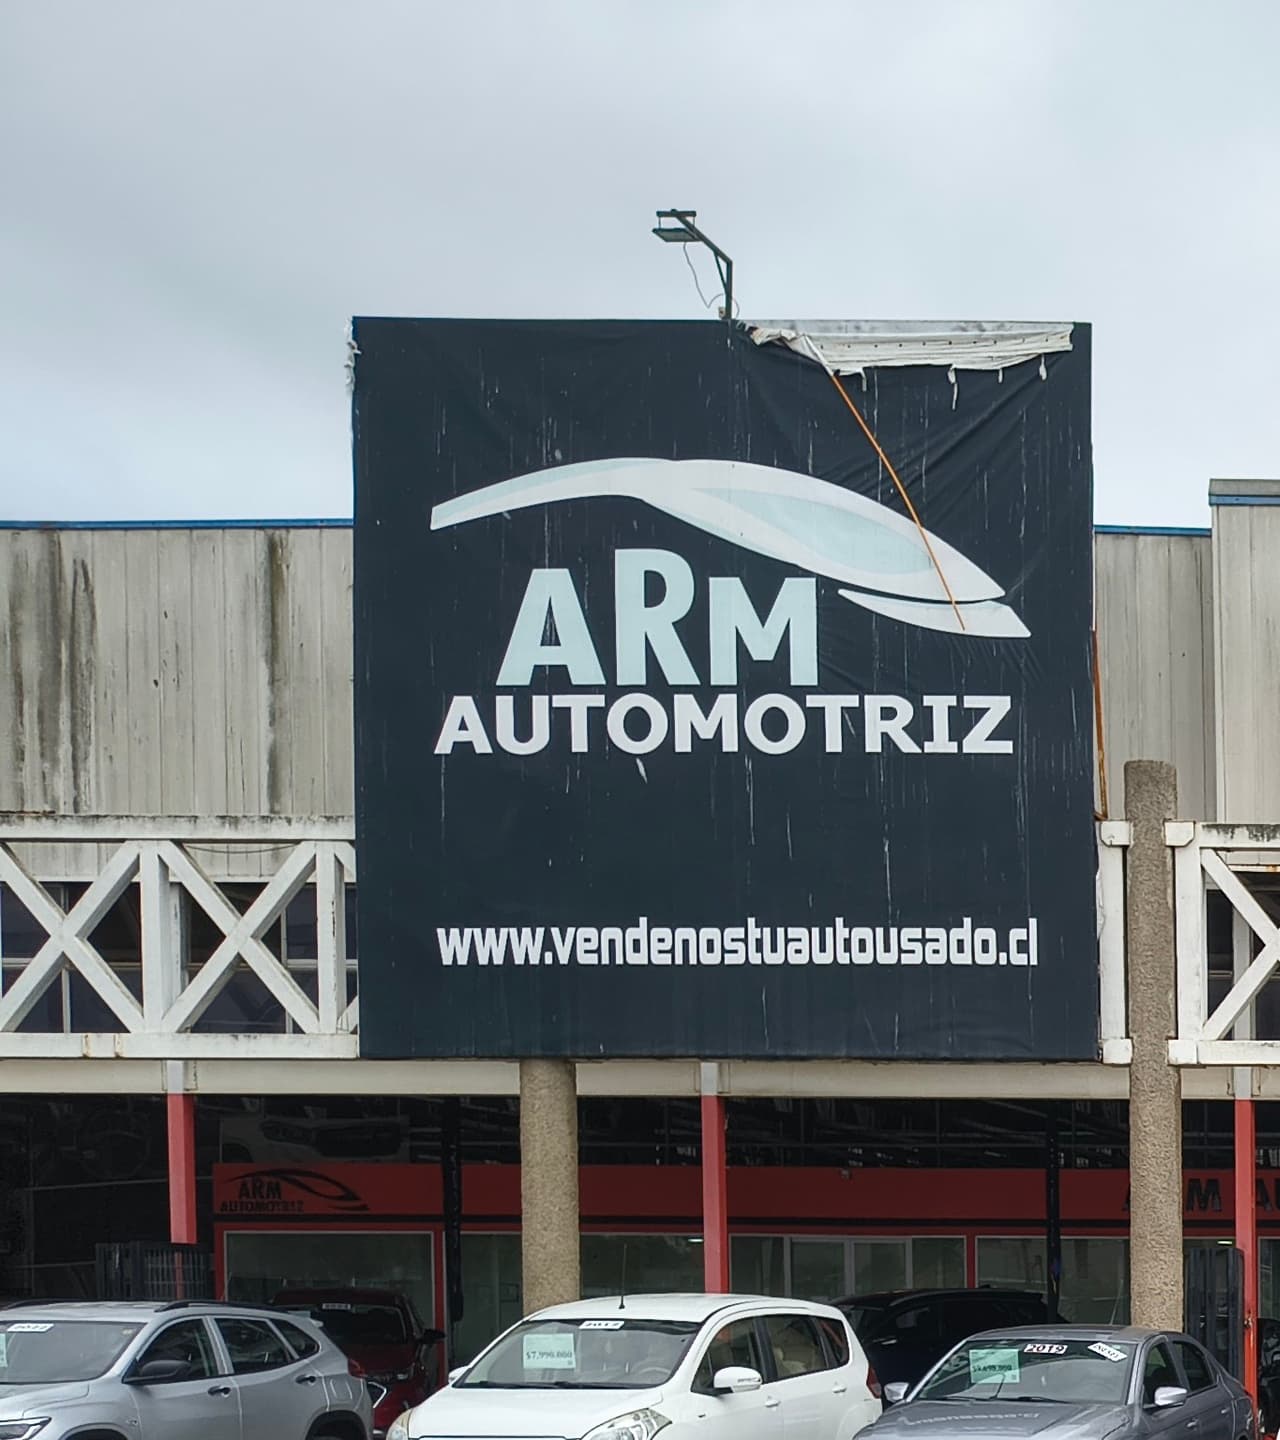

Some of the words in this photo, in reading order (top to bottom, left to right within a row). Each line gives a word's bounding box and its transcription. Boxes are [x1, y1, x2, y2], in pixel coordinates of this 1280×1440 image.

[495, 548, 819, 686] ARM
[434, 693, 1014, 755] AUTOMOTRIZ
[435, 916, 1039, 966] www.vendenostuautousado.cl
[238, 1177, 282, 1200] ARM
[1025, 1344, 1067, 1354] 2019
